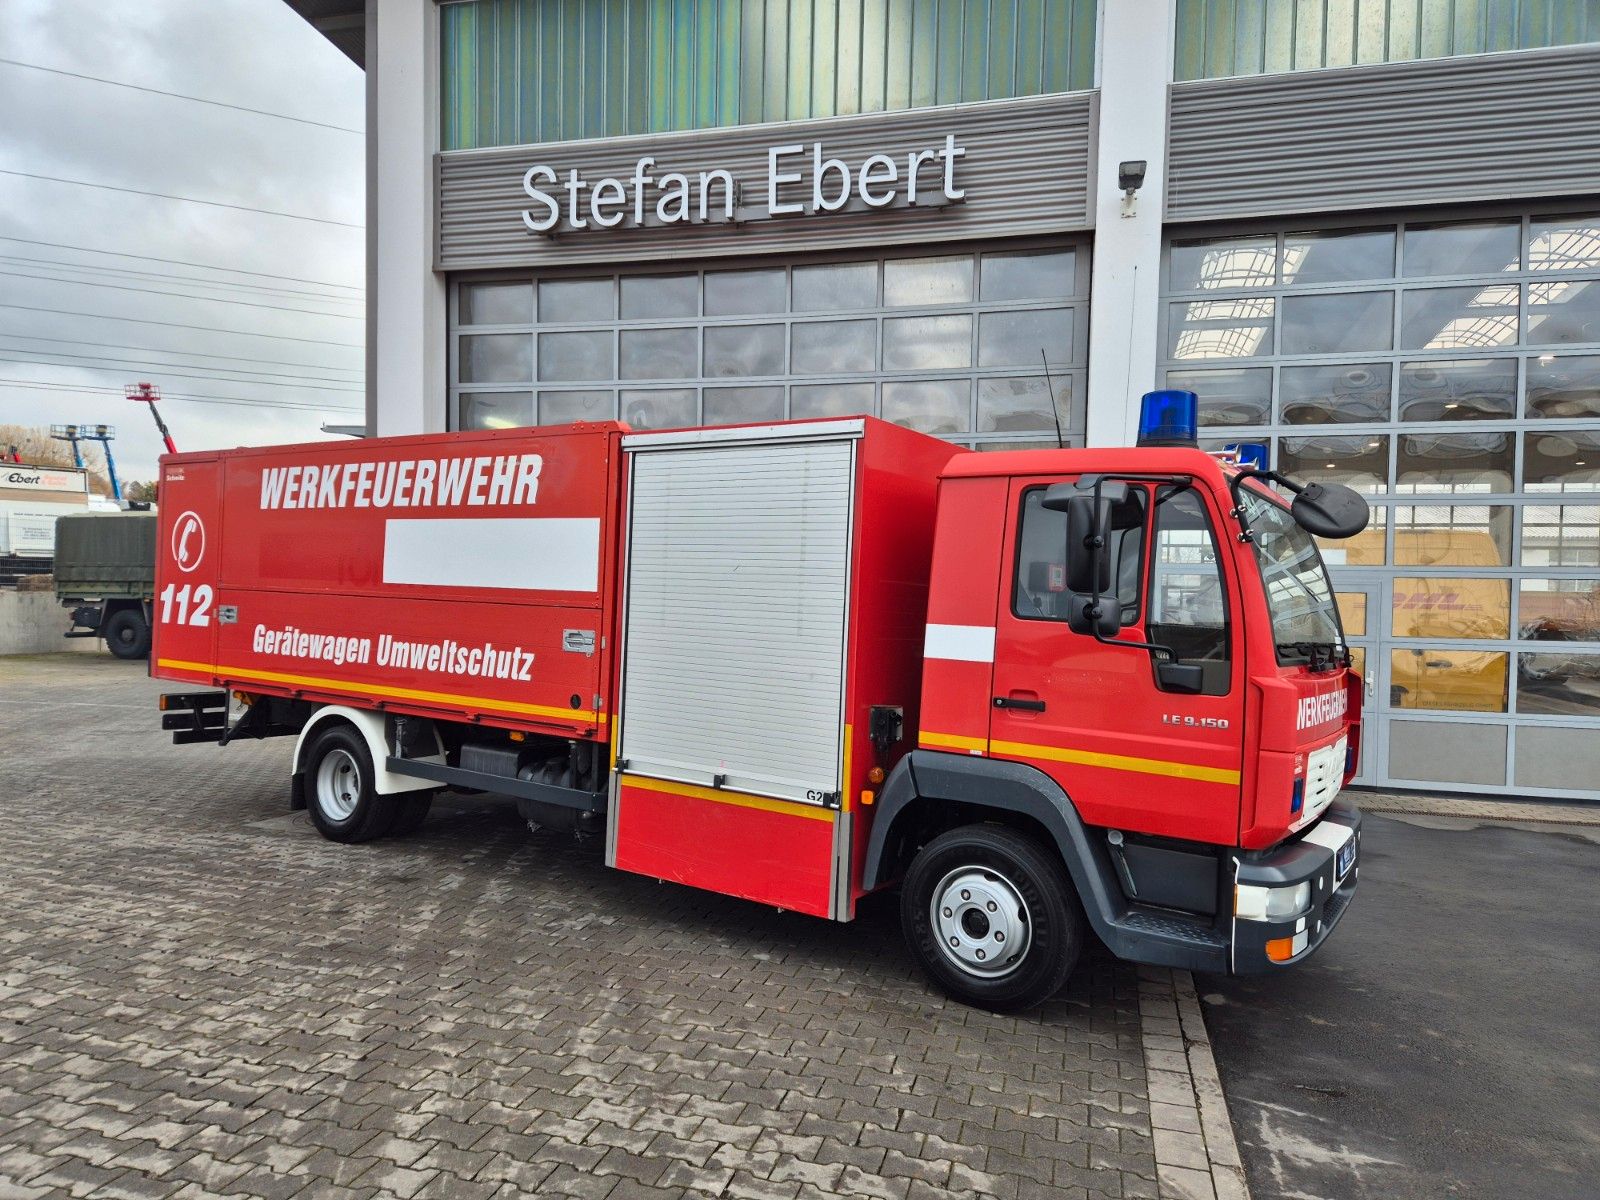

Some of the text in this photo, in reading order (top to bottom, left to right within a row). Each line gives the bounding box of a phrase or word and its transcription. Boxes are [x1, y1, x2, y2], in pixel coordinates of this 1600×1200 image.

[522, 135, 966, 232] Stefan Ebert
[8, 472, 41, 485] Ebert
[260, 453, 544, 511] WERKFEUERWEHR
[160, 583, 214, 627] 112
[252, 623, 536, 681] Gerätewagen Umweltschutz
[1162, 713, 1229, 729] LE 9.150
[806, 790, 823, 802] G2
